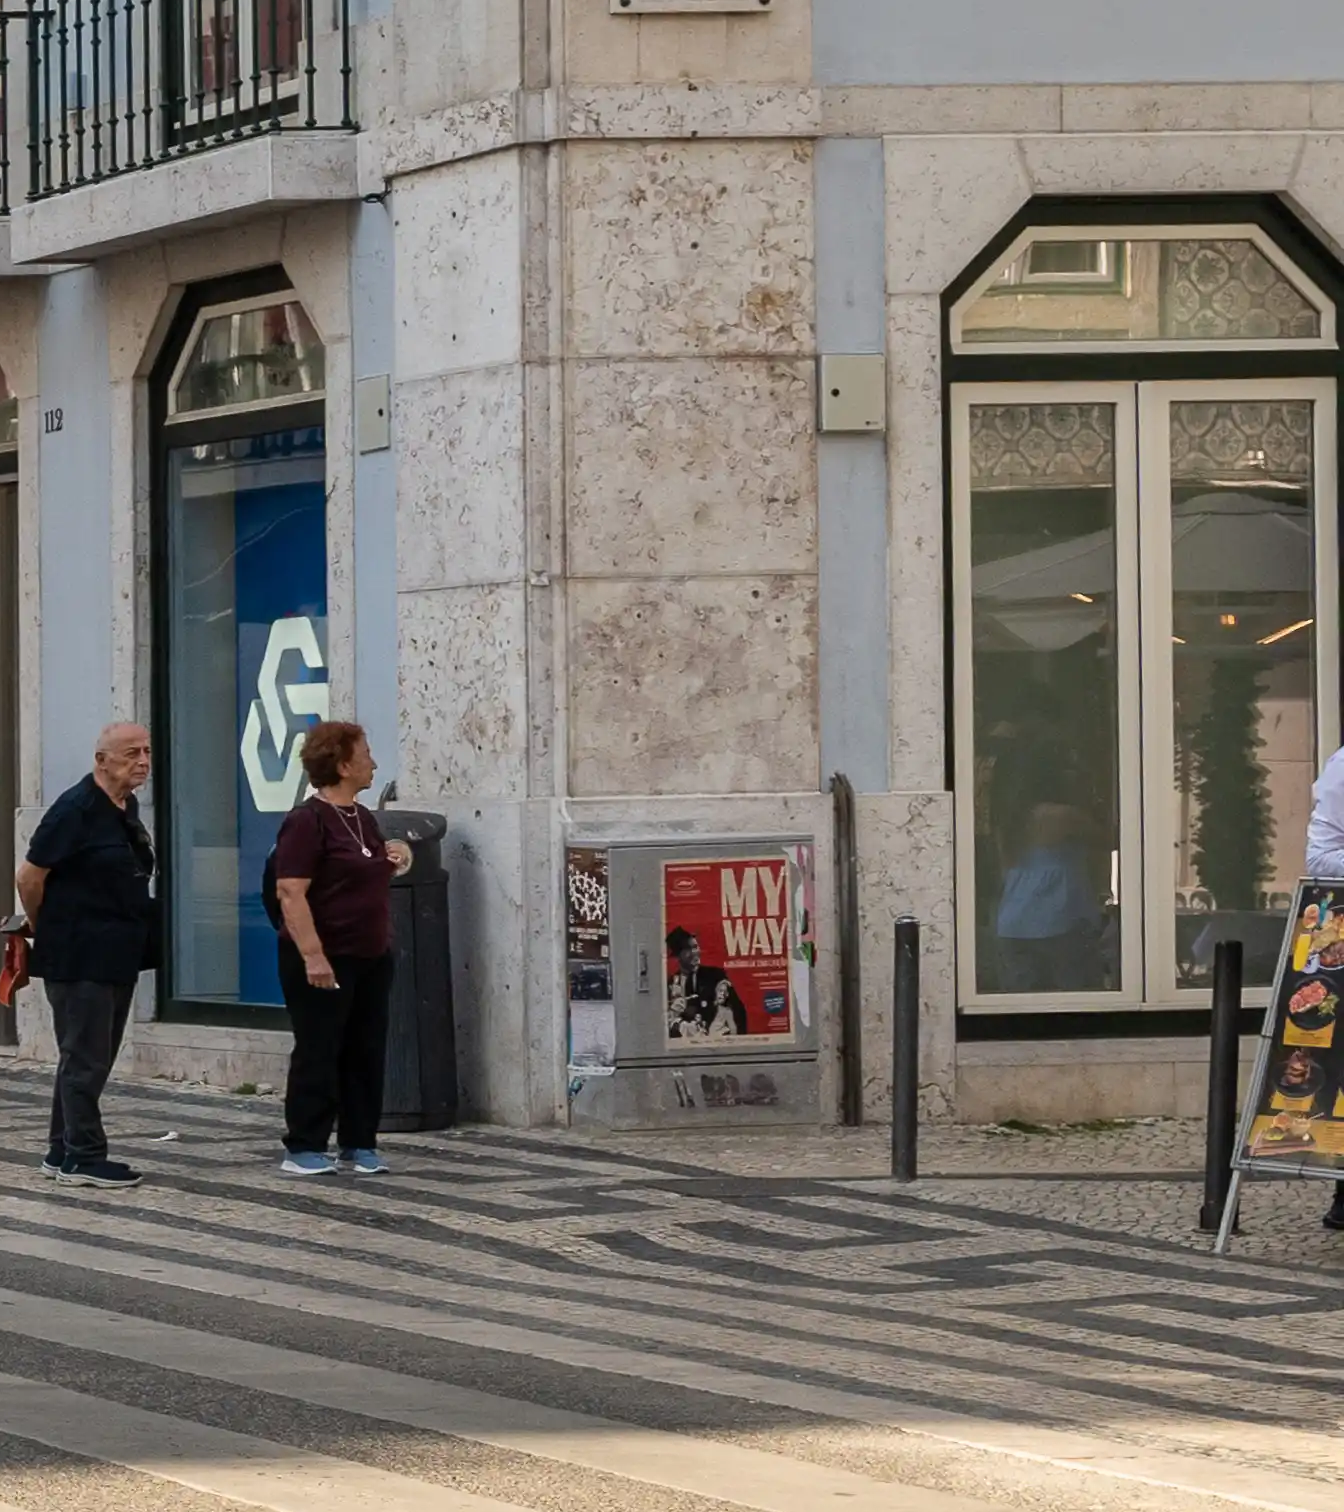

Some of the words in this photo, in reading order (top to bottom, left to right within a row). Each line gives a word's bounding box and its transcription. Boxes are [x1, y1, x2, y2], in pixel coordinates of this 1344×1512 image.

[44, 408, 64, 434] 112
[720, 865, 787, 917] MY
[722, 918, 788, 957] WAY
